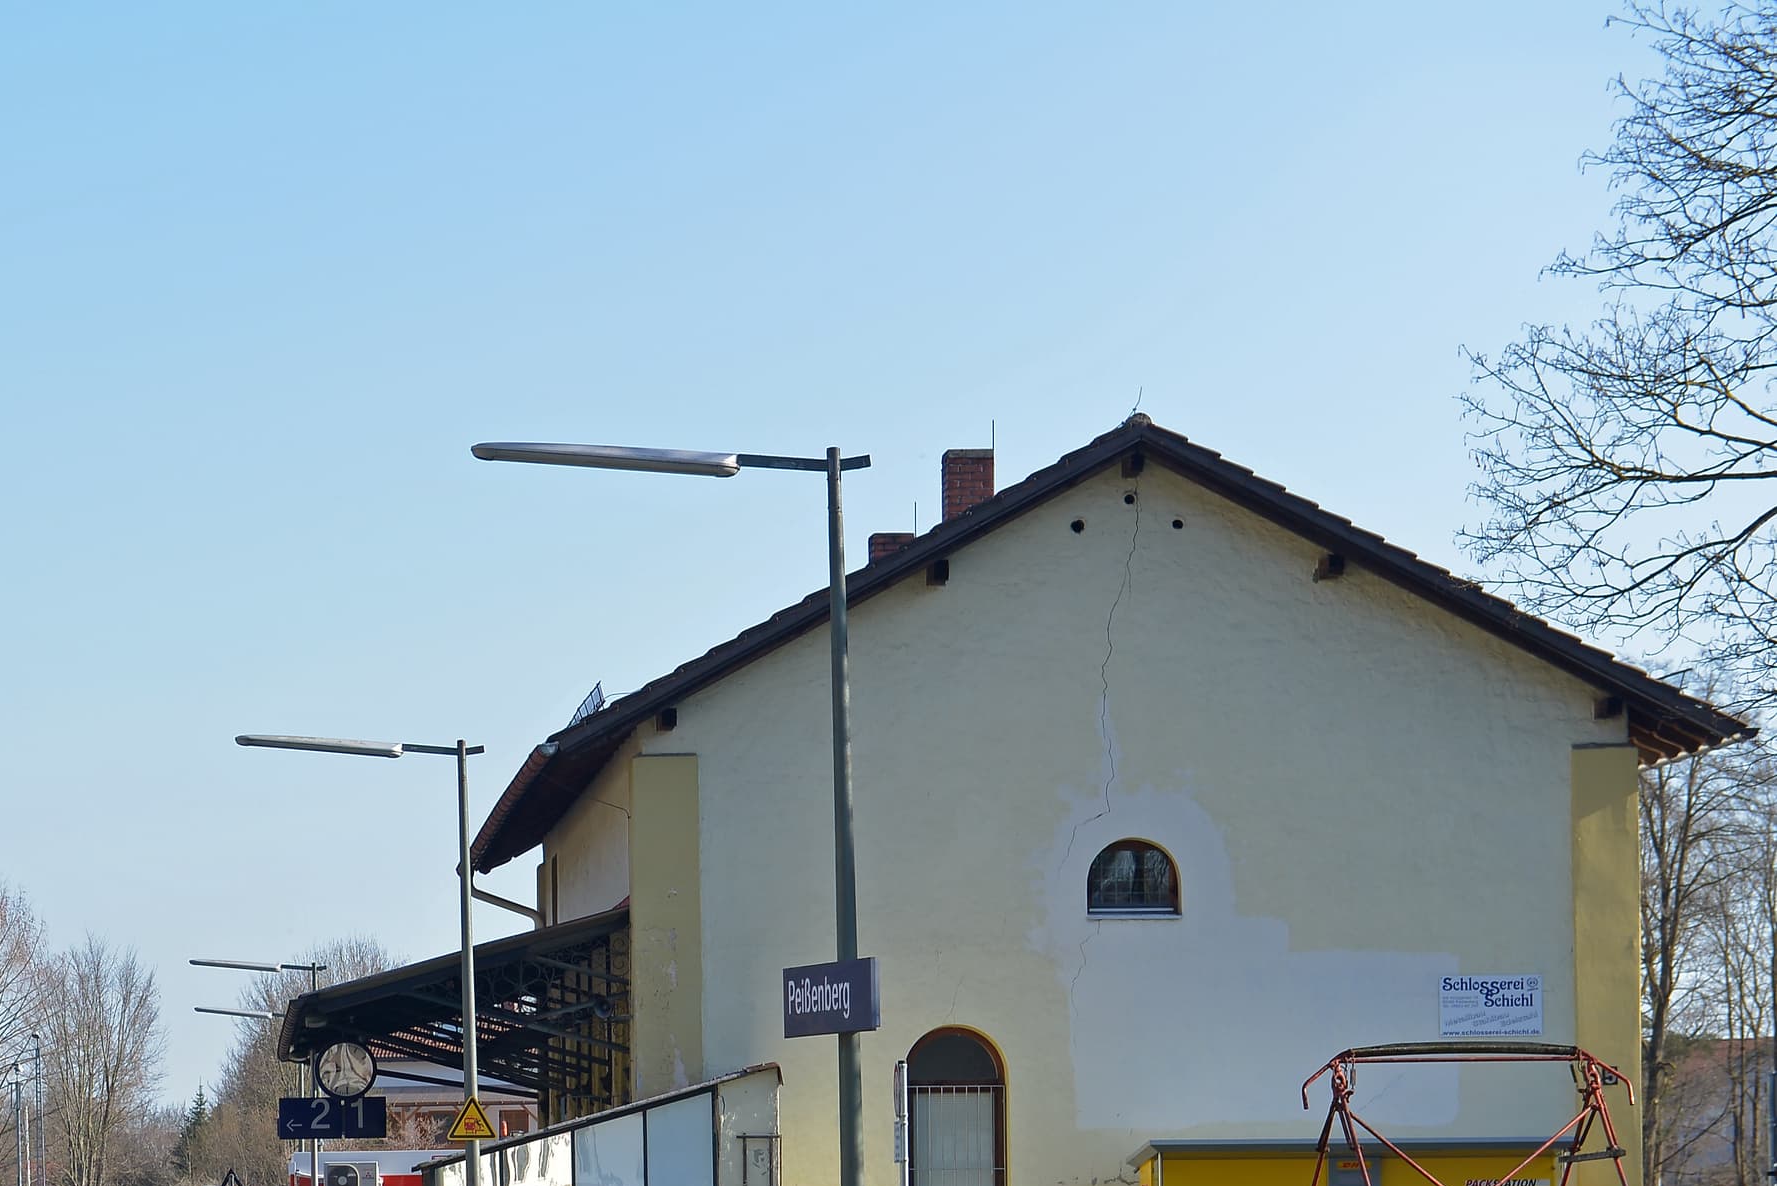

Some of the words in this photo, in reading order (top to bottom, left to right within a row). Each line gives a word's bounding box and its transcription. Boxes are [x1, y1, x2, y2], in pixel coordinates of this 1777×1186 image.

[788, 976, 850, 1019] Peißenberg
[1442, 977, 1524, 995] Schlosserei
[1484, 993, 1533, 1007] Schichl
[310, 1098, 331, 1129] 2
[350, 1097, 364, 1129] 1
